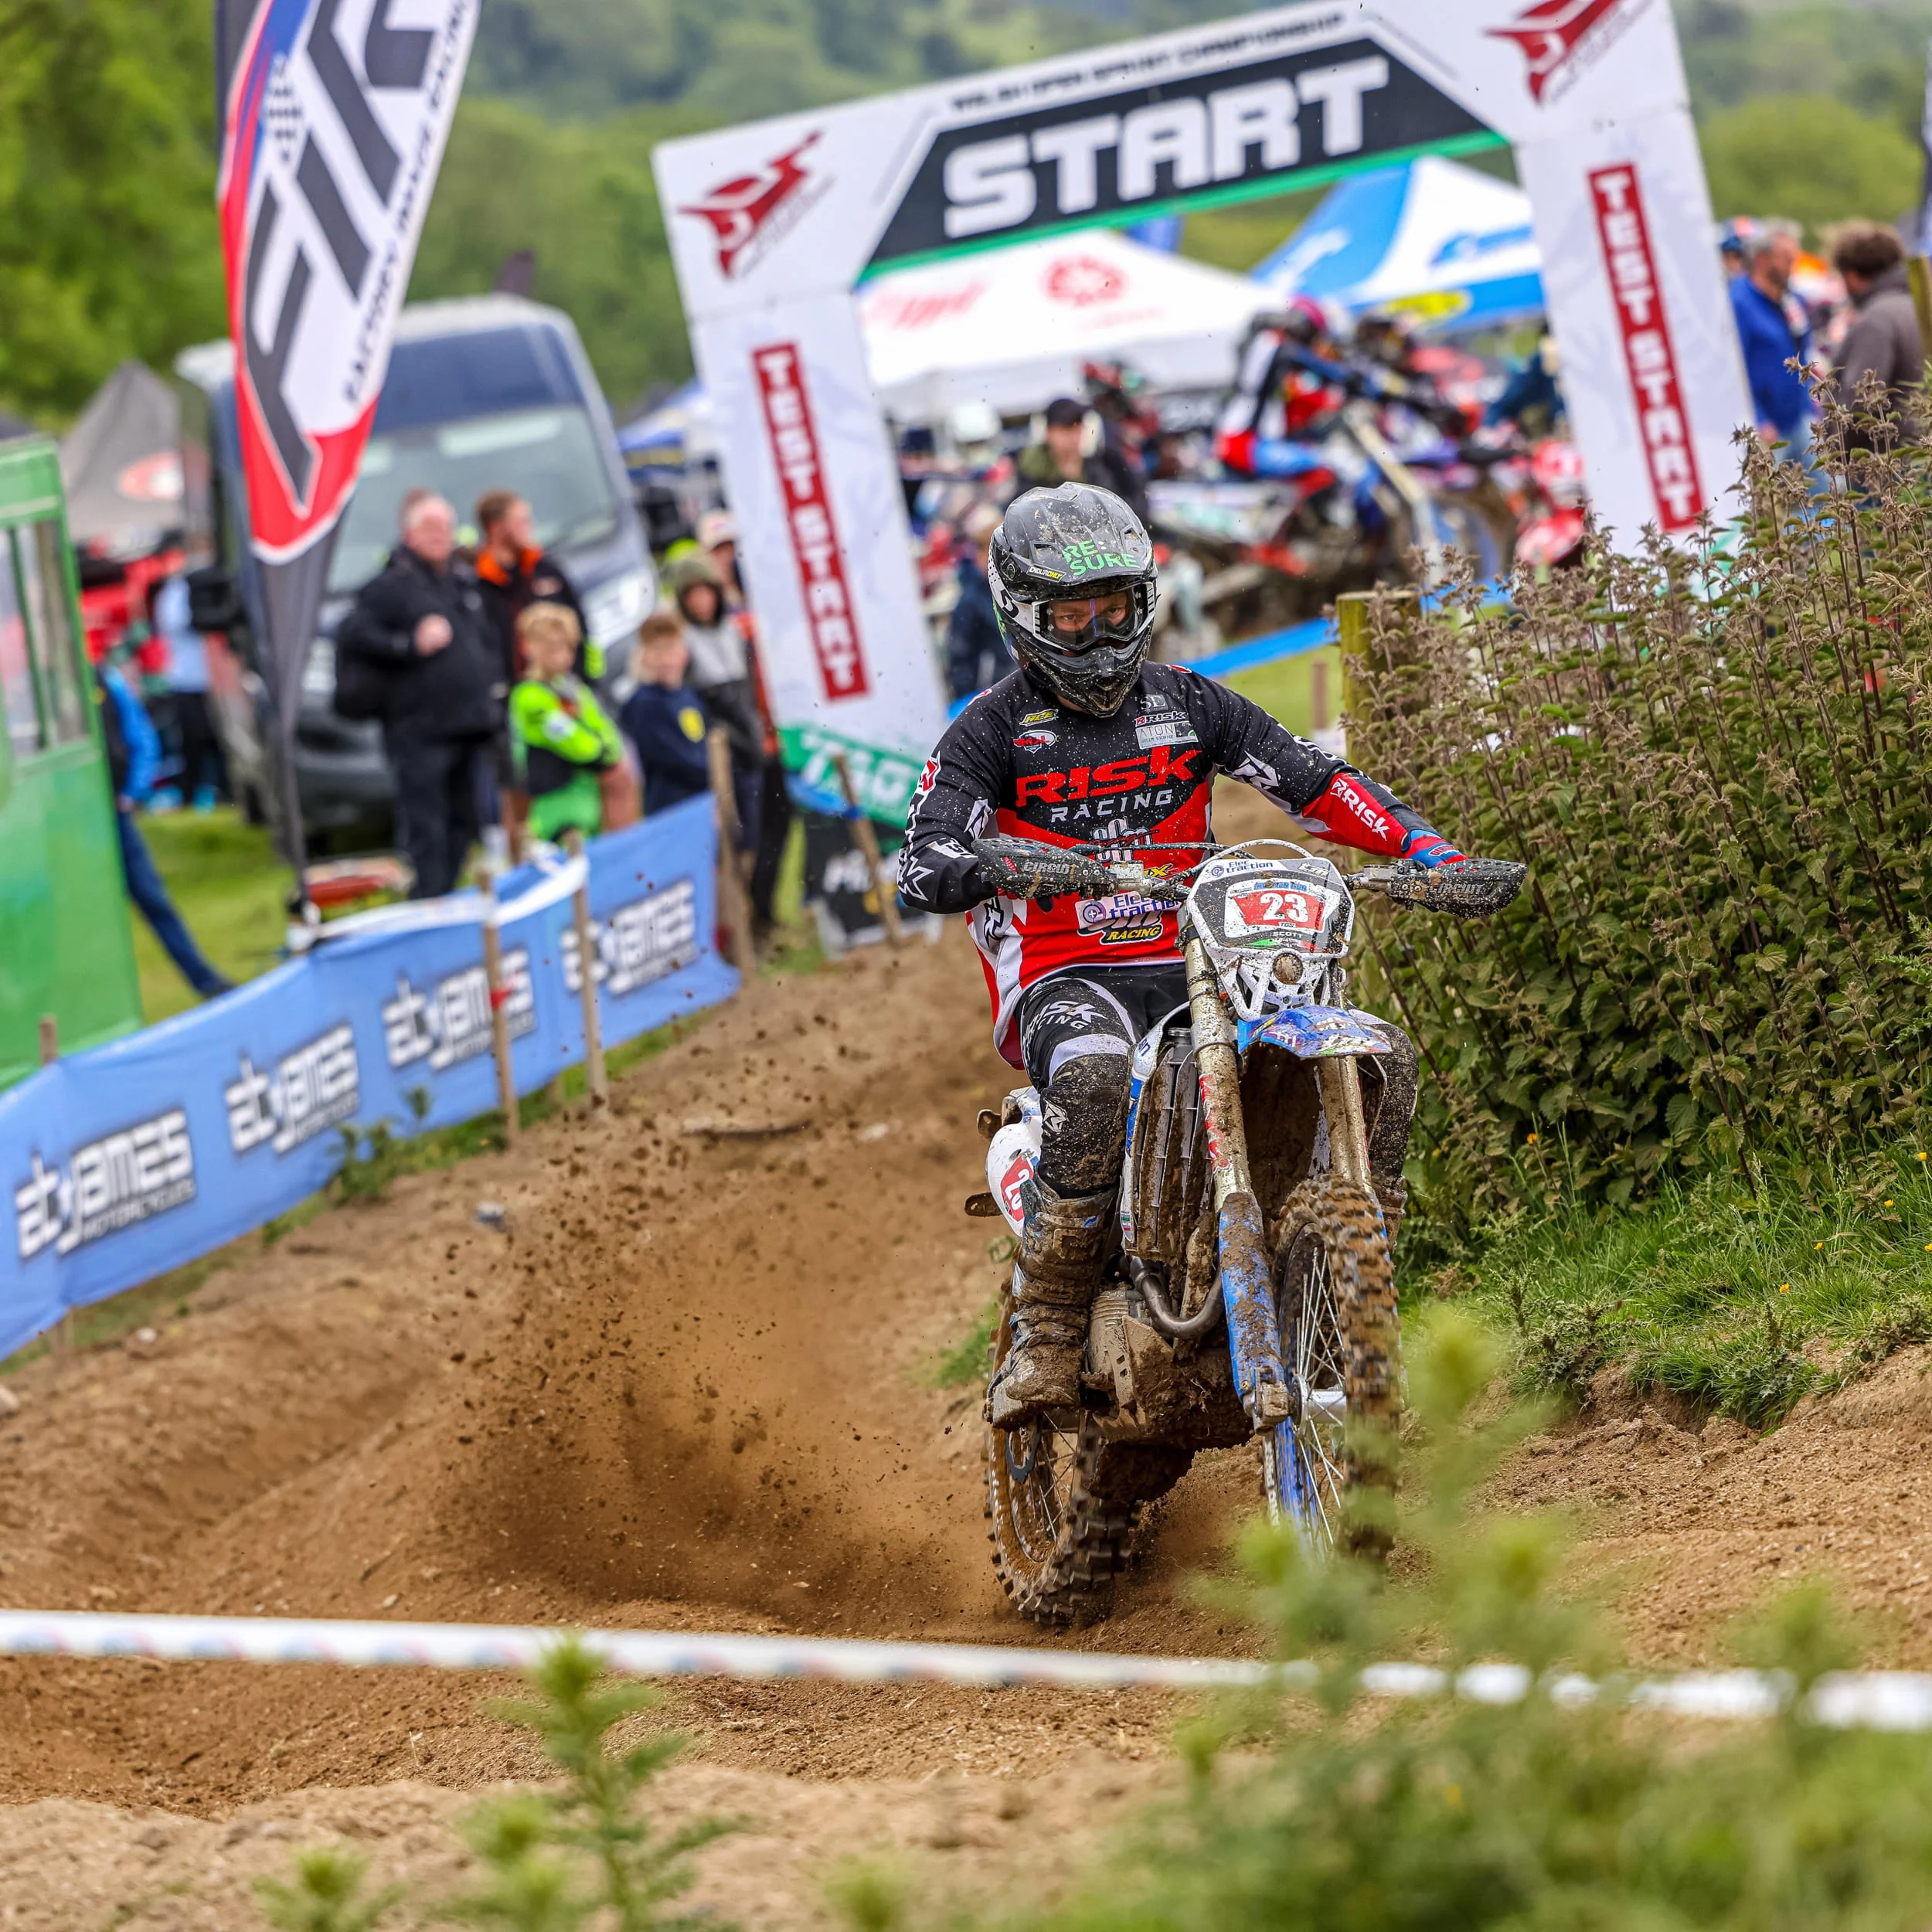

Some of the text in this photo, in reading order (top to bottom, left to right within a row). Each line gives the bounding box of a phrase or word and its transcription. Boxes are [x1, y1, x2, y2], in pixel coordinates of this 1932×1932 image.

[943, 56, 1389, 238] START
[1592, 170, 1659, 328] TEST
[759, 350, 816, 500] TEST
[1070, 553, 1141, 576] SURE
[1145, 711, 1187, 723] RISK
[1140, 723, 1174, 739] ATON
[1015, 745, 1202, 808] RISK
[1050, 789, 1173, 823] RACING
[1342, 788, 1390, 842] RISK
[1226, 862, 1274, 873] traction
[1228, 860, 1248, 869] Elec
[1108, 900, 1179, 919] tractio
[1260, 893, 1309, 923] 23
[1106, 927, 1161, 941] RACING
